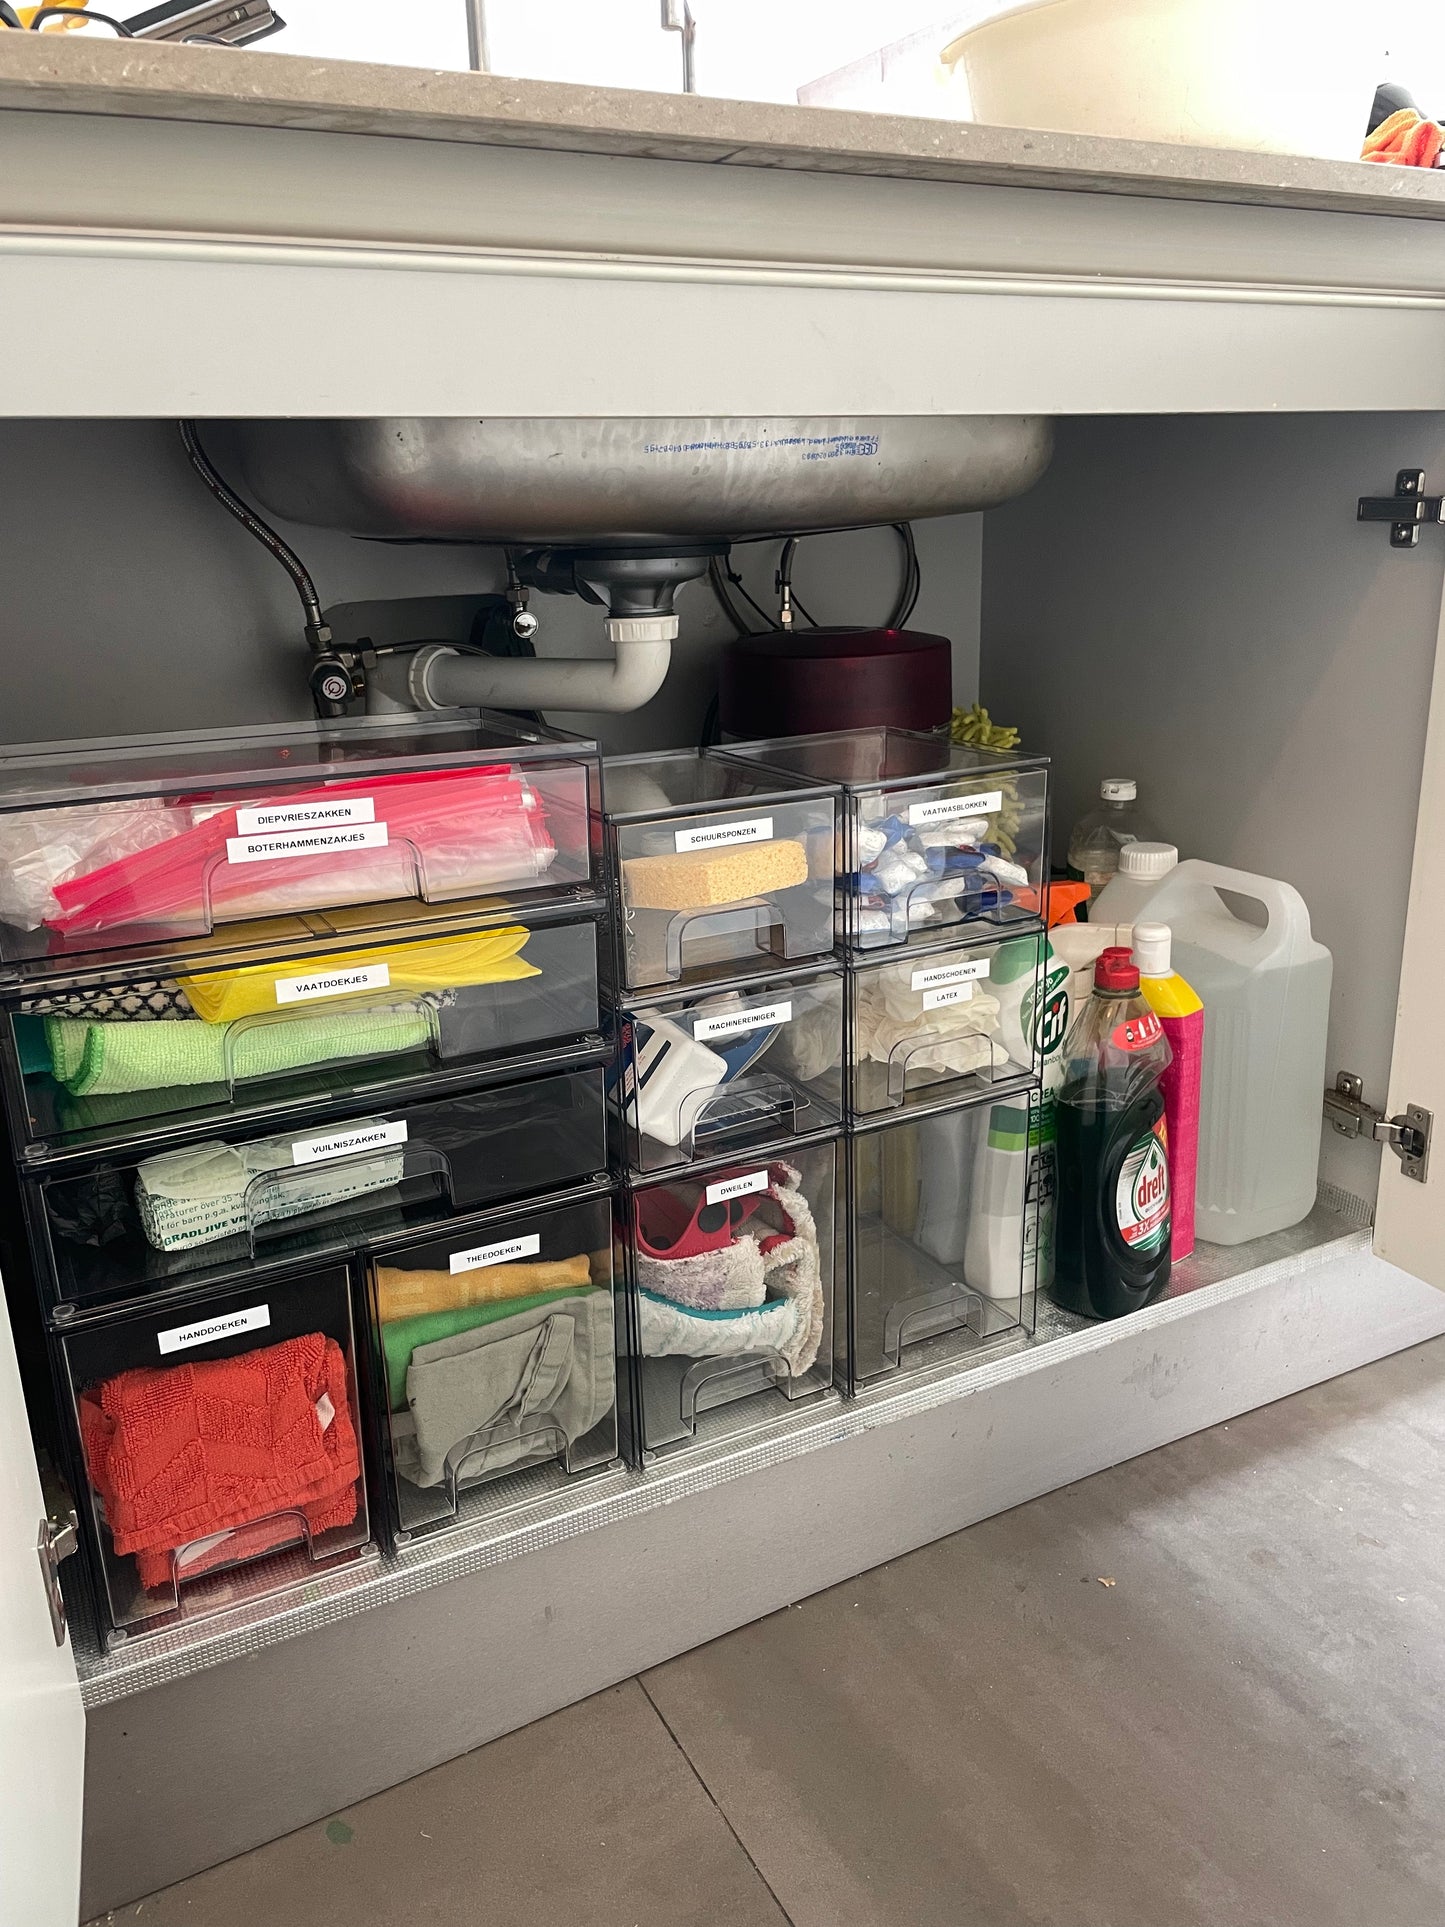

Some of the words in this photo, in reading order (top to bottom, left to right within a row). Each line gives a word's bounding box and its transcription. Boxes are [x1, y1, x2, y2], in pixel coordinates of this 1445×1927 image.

[258, 809, 352, 825] DIEPVRIESZAKKEN
[922, 800, 988, 816] VAATWASBLOKKEN
[248, 833, 365, 853] BOTERHAMMENZAKJES
[691, 827, 757, 844] SCHUURSPONZEN
[296, 974, 368, 993] VAATDOEKJES
[924, 967, 976, 982] HANDSCHOENEN
[936, 991, 958, 1002] LATEX
[709, 1011, 776, 1032] MACHINEREINIGER
[1037, 995, 1067, 1048] Cif
[312, 1132, 387, 1154] VUILNISZAKKEN
[720, 1181, 753, 1195] DWEILEN
[1138, 1164, 1166, 1207] dreft
[182, 1214, 203, 1226] barn
[164, 1221, 229, 1247] GRADLJIVE
[467, 1245, 522, 1263] THEEDOEKEN
[179, 1317, 248, 1342] HANDDOEKEN
